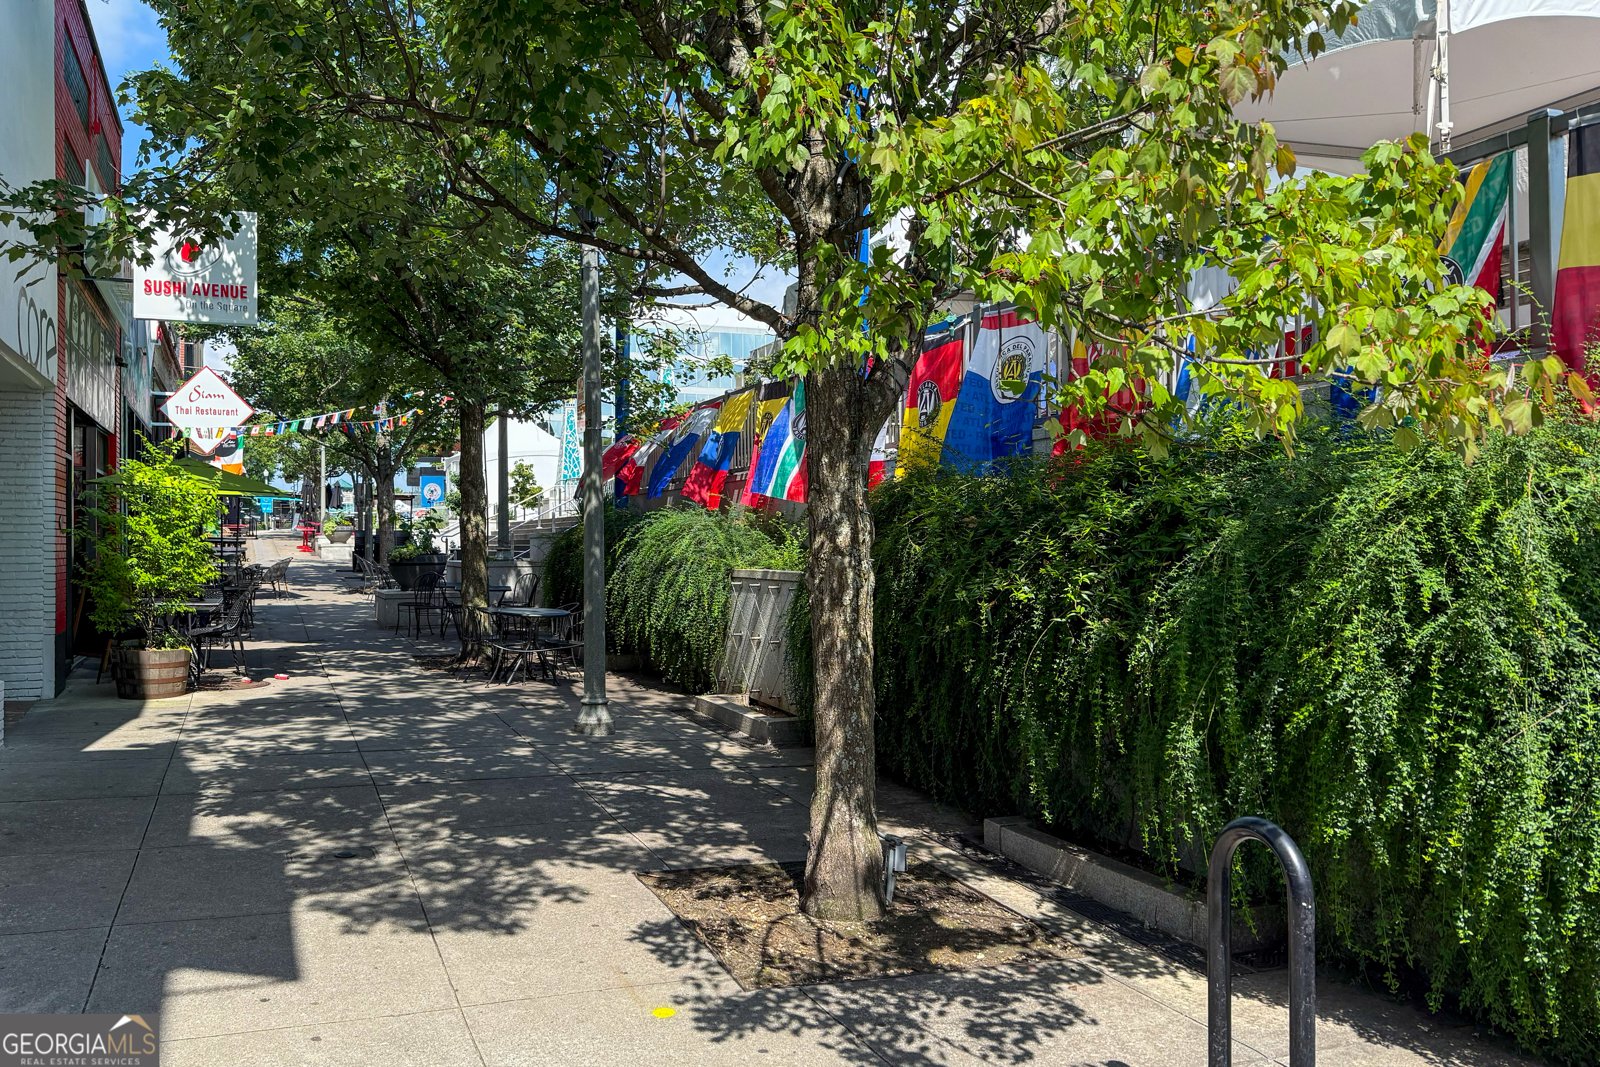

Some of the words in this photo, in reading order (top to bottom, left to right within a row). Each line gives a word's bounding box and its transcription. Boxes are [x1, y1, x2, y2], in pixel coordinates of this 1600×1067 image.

[144, 279, 187, 297] SUSHI
[192, 282, 248, 299] AVENUE
[186, 300, 197, 310] On
[200, 300, 214, 311] the
[217, 301, 248, 313] Square
[188, 384, 225, 403] Siam
[175, 405, 192, 415] Thai
[195, 406, 239, 417] Restaurant
